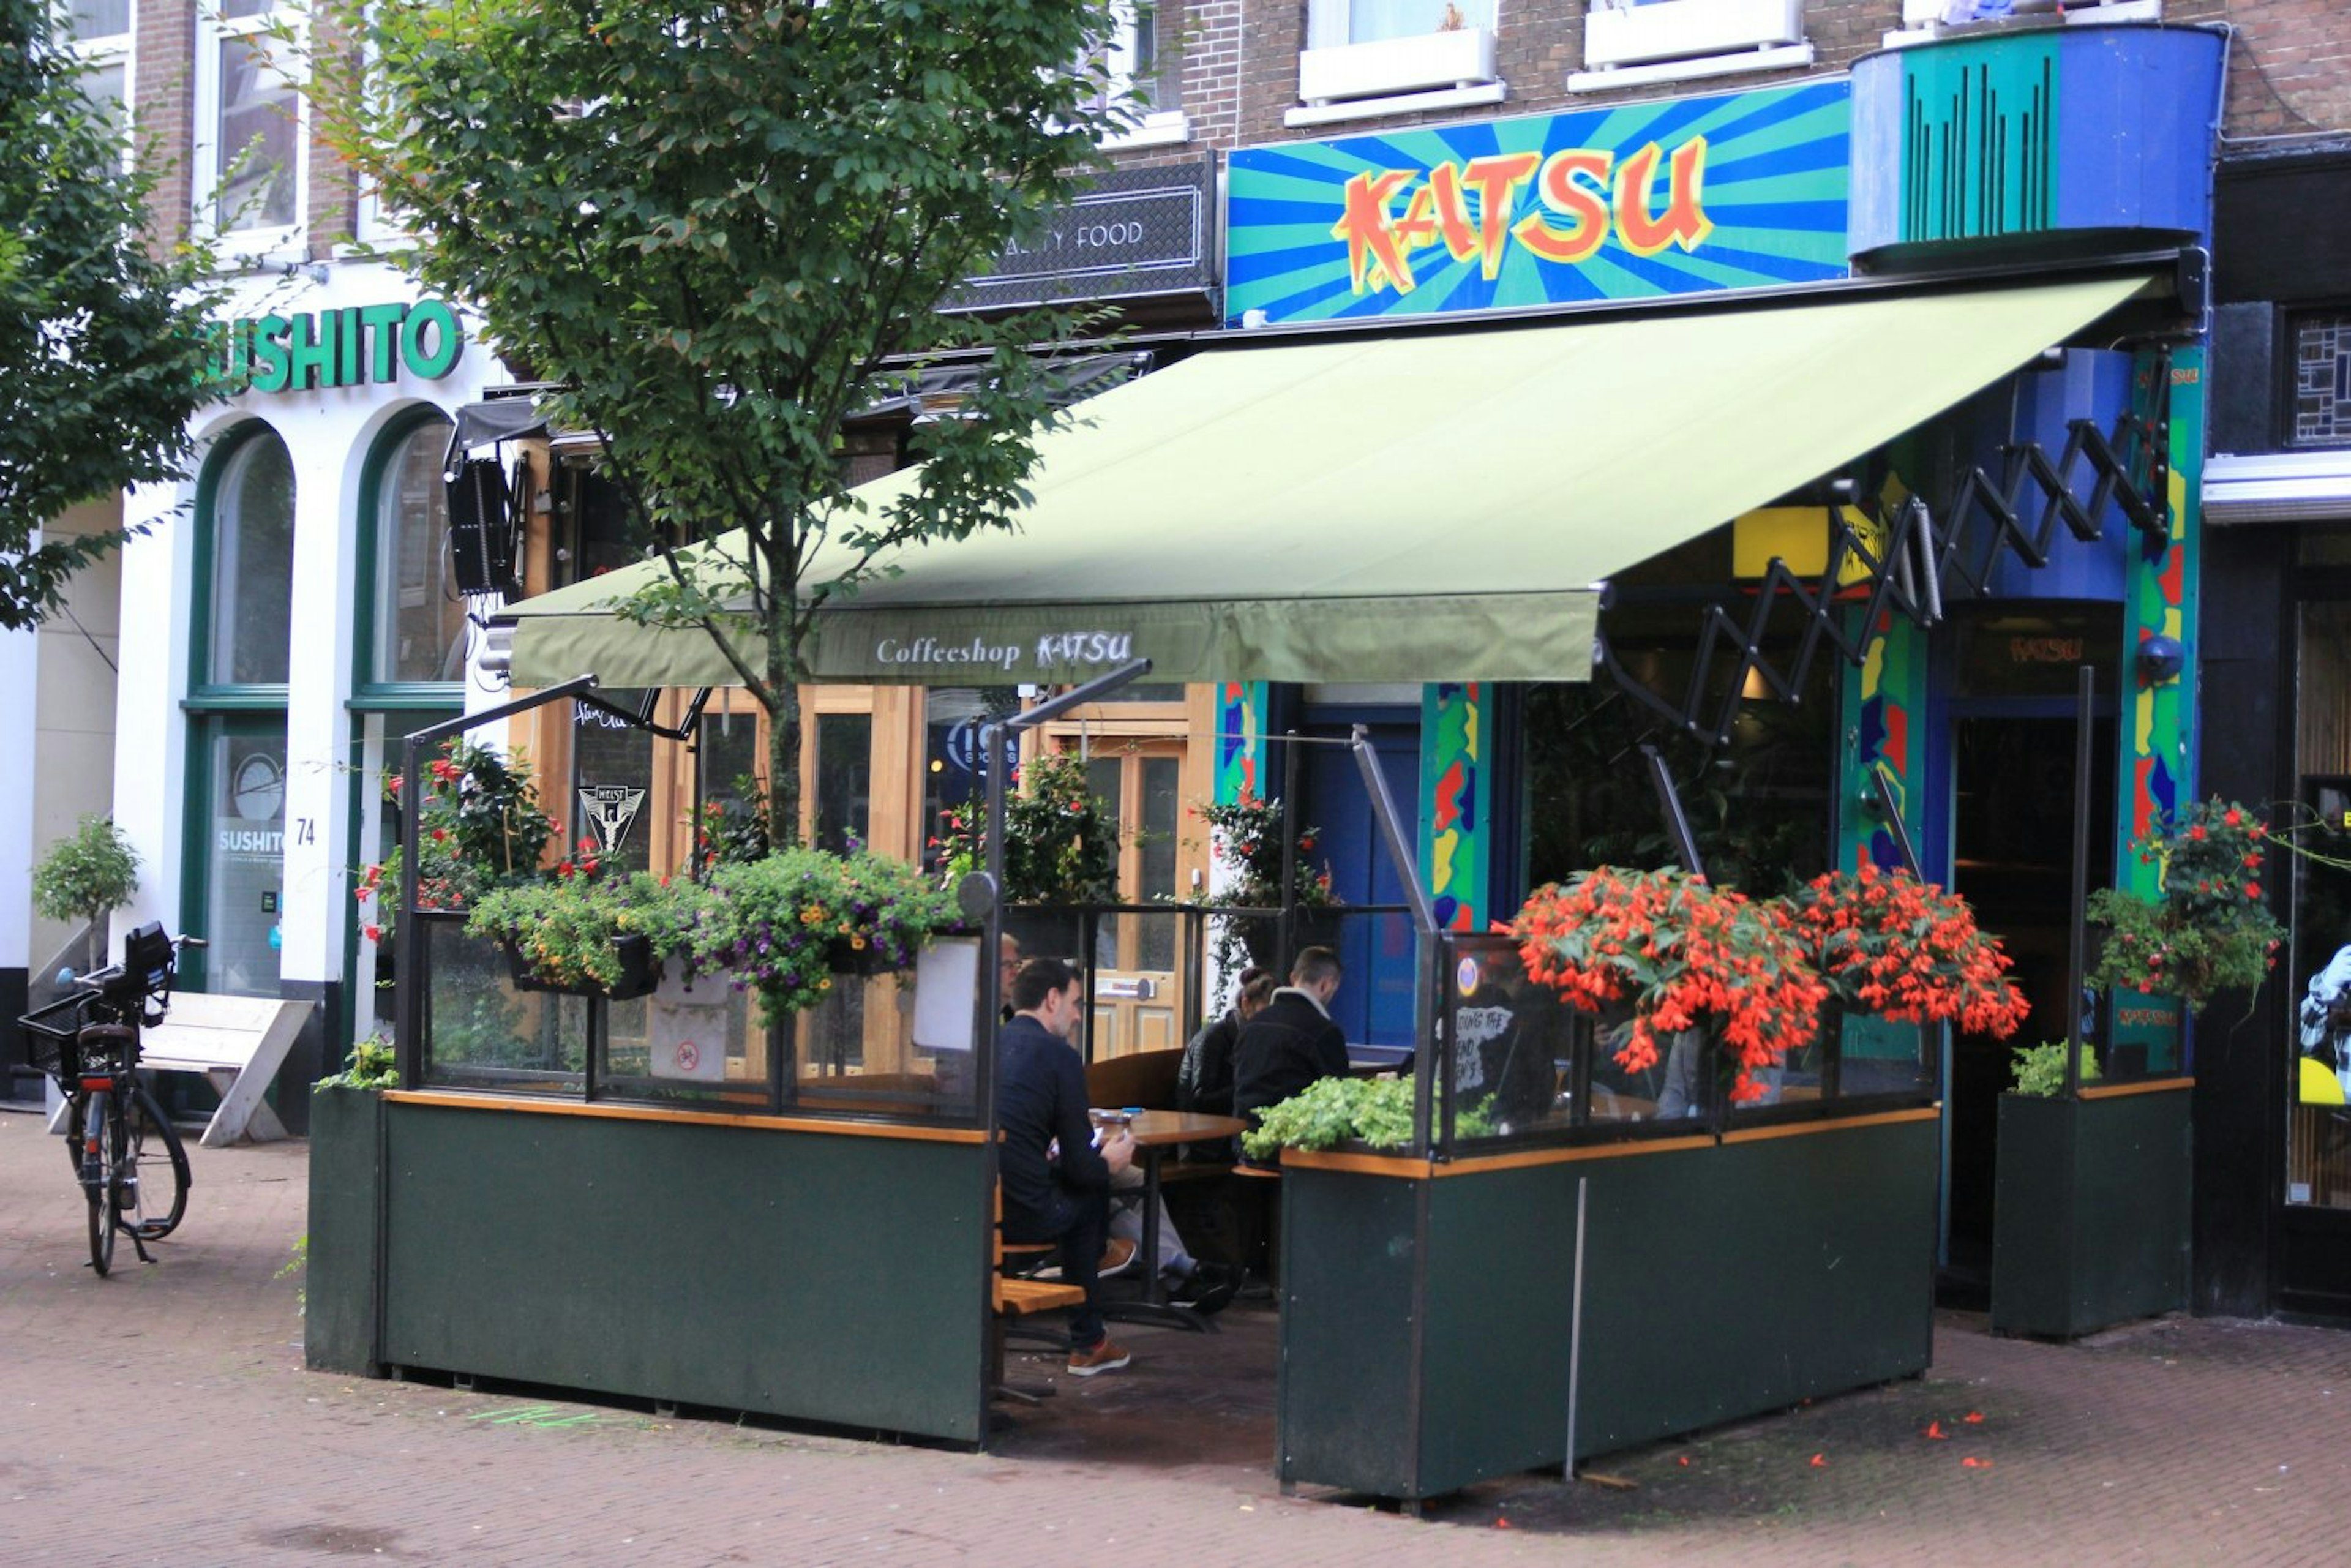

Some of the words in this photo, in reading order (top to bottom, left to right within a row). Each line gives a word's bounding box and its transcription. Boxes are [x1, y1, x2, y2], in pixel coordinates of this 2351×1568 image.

[1329, 133, 1715, 296] KATSU
[1076, 221, 1143, 248] FOOD
[190, 298, 463, 397] USHITO
[876, 636, 1021, 670] Coffeeshop
[1036, 631, 1134, 669] KATSU
[296, 818, 315, 846] 74
